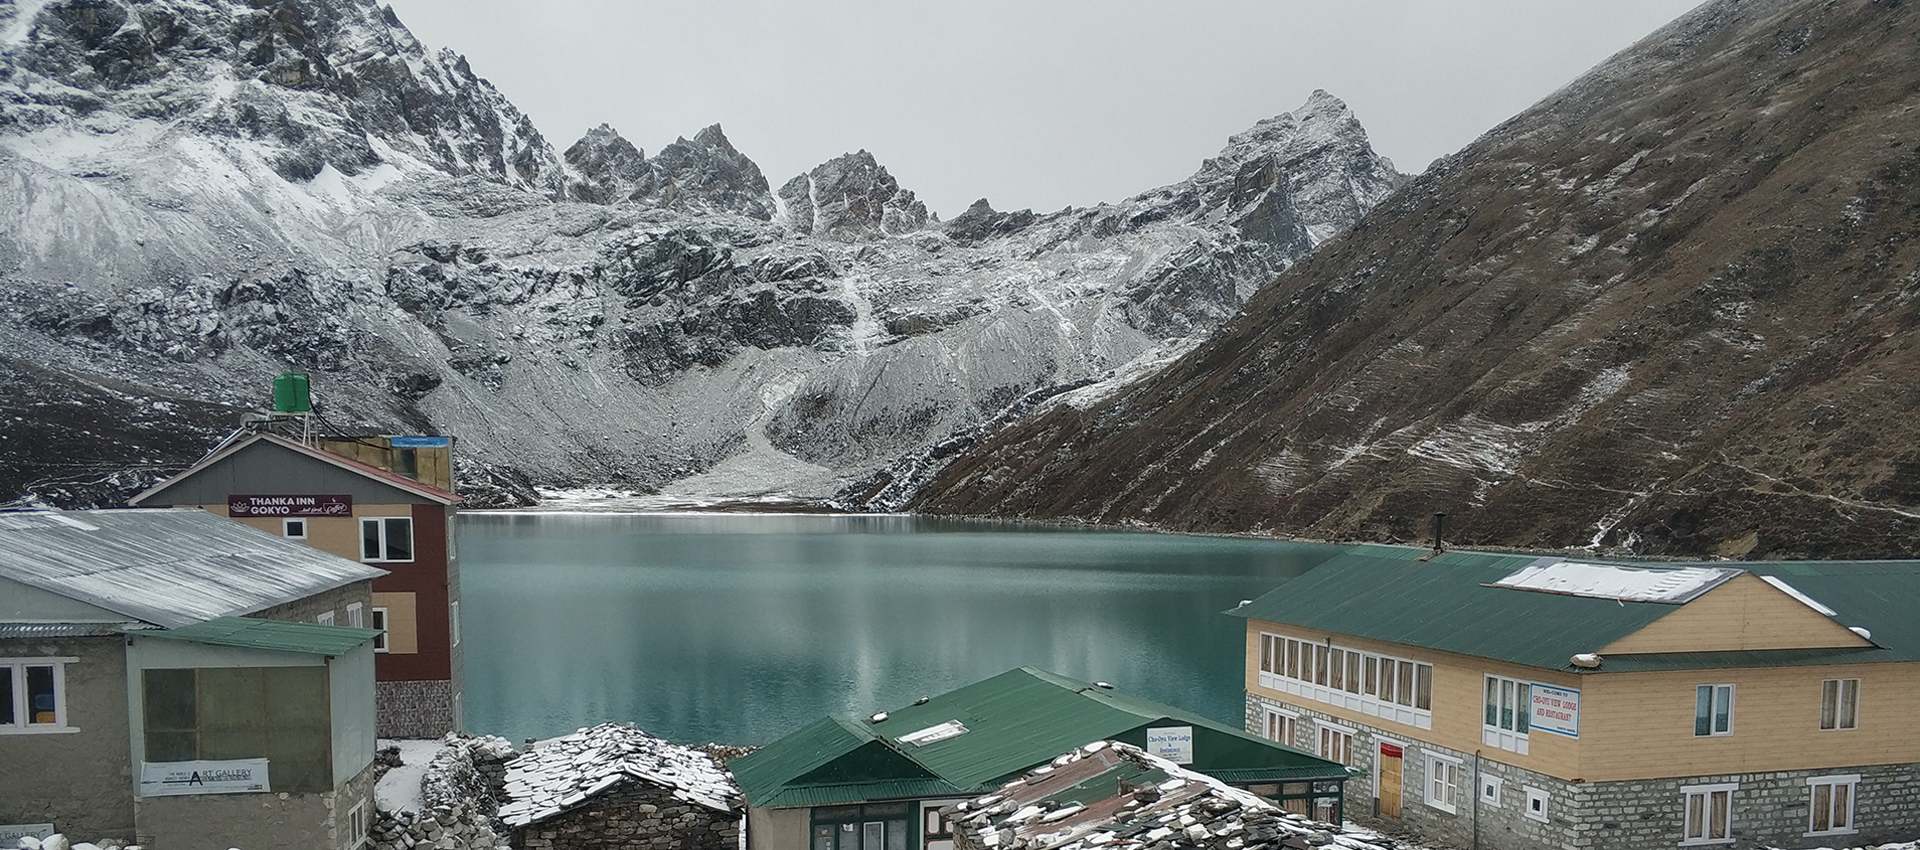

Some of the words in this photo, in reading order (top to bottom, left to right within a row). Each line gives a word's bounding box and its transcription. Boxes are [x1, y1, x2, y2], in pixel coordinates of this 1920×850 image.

[251, 506, 289, 514] GOKYO
[1552, 698, 1561, 707] VIEW
[1562, 701, 1577, 711] LODGE
[1536, 708, 1545, 716] AND
[215, 768, 252, 777] GALLERY
